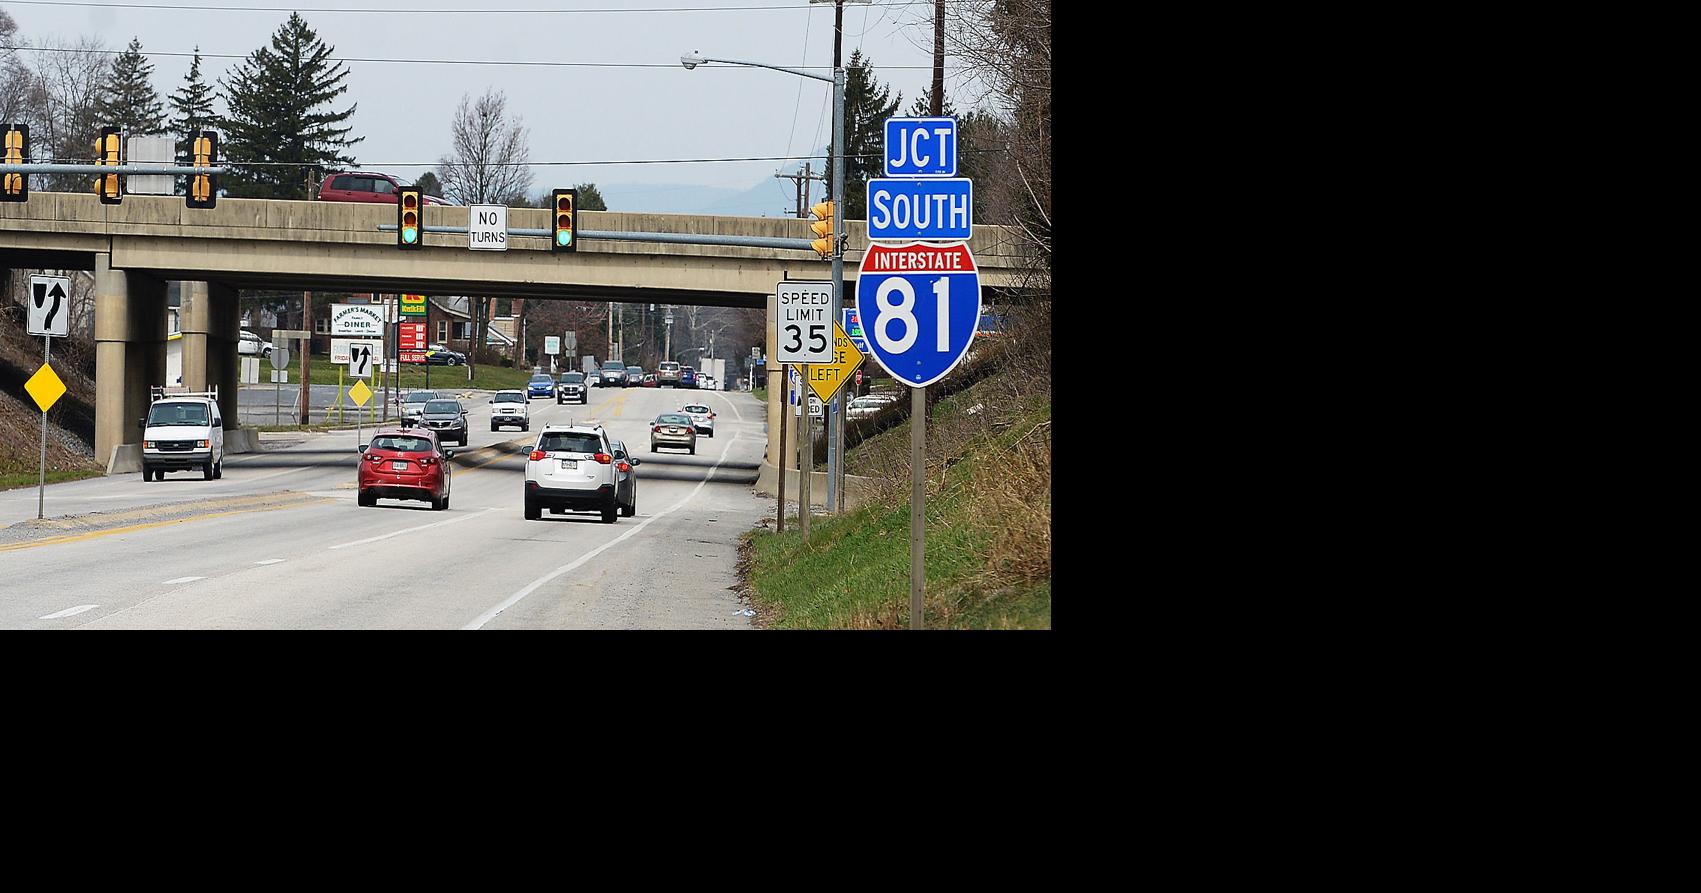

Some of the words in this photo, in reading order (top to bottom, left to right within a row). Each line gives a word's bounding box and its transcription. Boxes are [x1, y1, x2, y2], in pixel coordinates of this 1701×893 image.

[890, 128, 952, 168] JCT
[872, 189, 967, 229] SOUTH
[479, 211, 498, 225] NO
[471, 231, 505, 243] TURNS
[874, 252, 962, 269] INTERSTATE
[781, 292, 829, 305] SPEED
[333, 307, 359, 323] FARMER'S
[360, 307, 382, 323] MARKET
[786, 309, 824, 321] LIMIT
[874, 276, 950, 354] 81
[783, 324, 828, 353] 35
[810, 368, 841, 381] LEFT
[808, 405, 820, 413] ED
